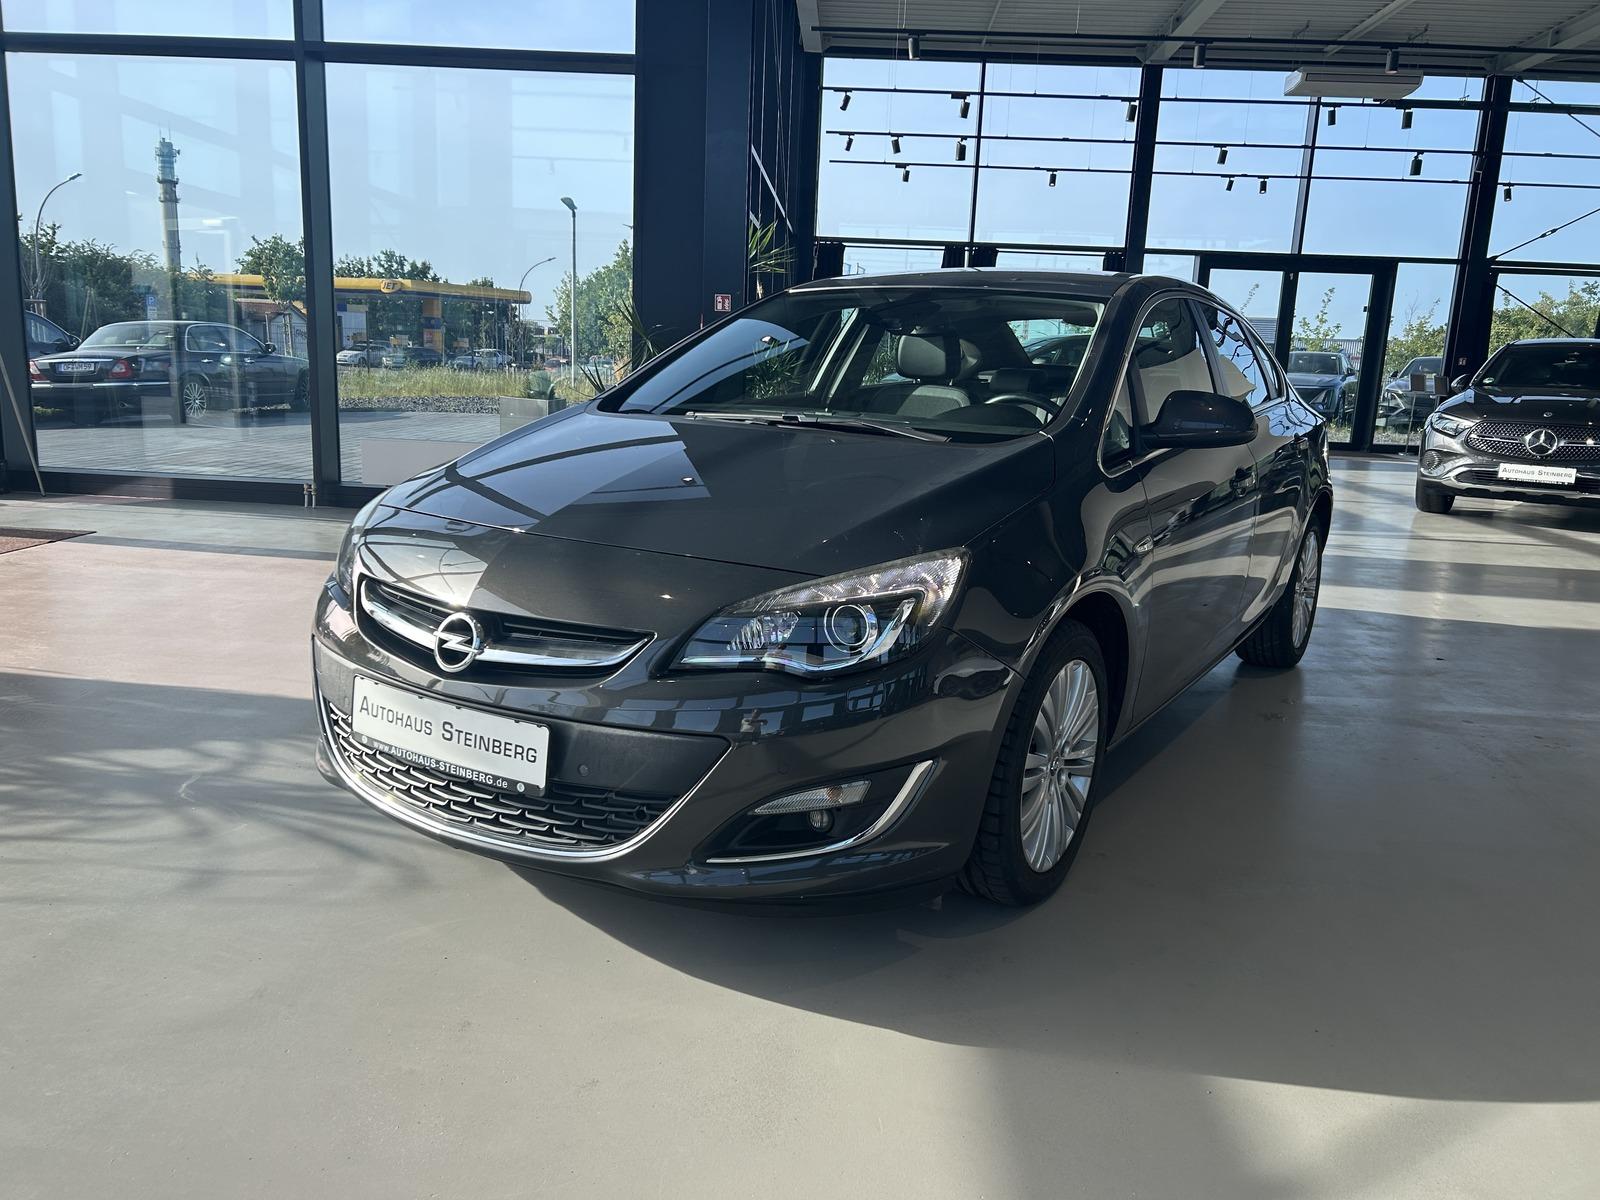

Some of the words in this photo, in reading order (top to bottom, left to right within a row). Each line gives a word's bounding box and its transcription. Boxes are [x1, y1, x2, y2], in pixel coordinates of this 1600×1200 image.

[382, 282, 398, 290] JET
[1502, 467, 1535, 475] AUTOHAUS
[1537, 469, 1573, 478] STEINBERG
[359, 695, 433, 736] AUTOHAUS
[441, 721, 537, 764] STEINBERG
[373, 741, 508, 789] www.AUTOHAUS-STEINBERG.de
